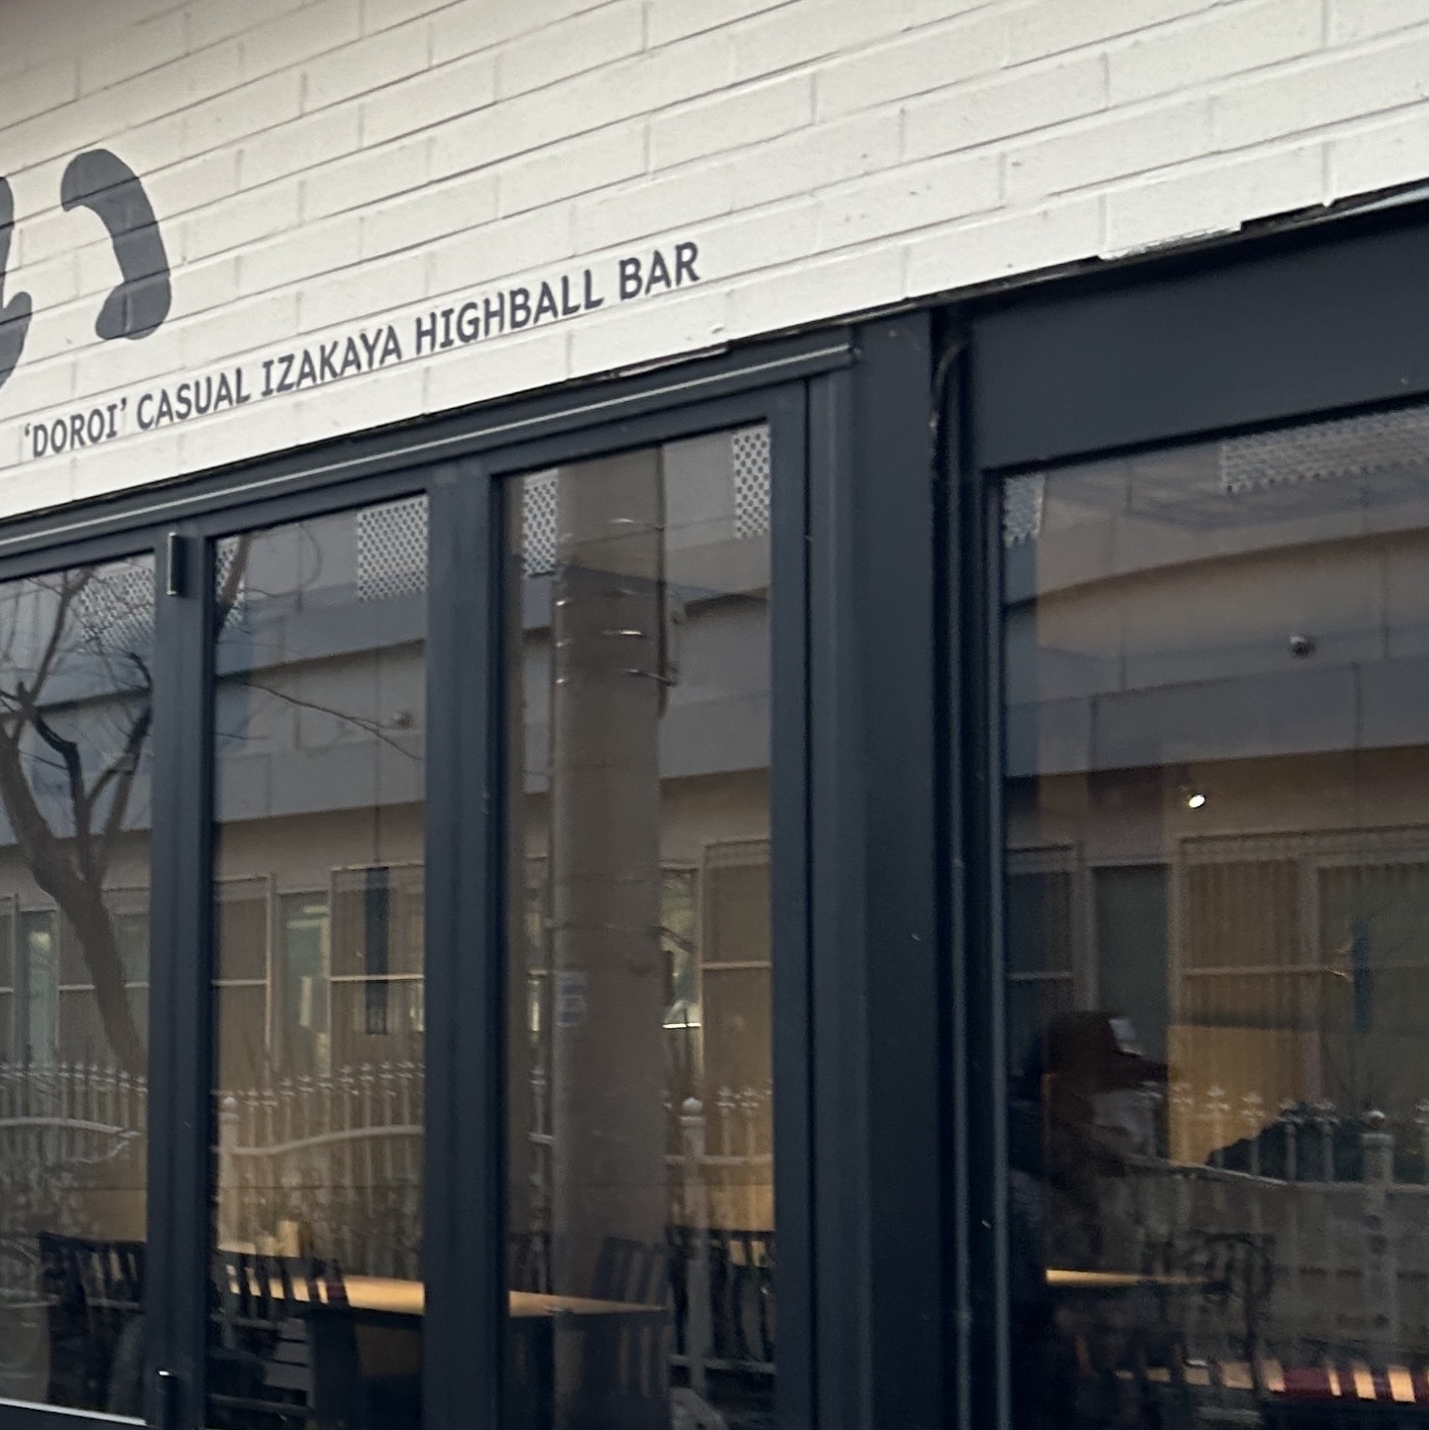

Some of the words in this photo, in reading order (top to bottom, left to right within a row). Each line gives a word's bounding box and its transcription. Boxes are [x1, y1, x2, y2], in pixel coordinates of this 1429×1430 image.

[136, 366, 251, 431] CASUAL
[261, 324, 403, 397] IZAKAYA
[415, 269, 603, 355] HIGHBALL
[618, 241, 700, 301] BAR
